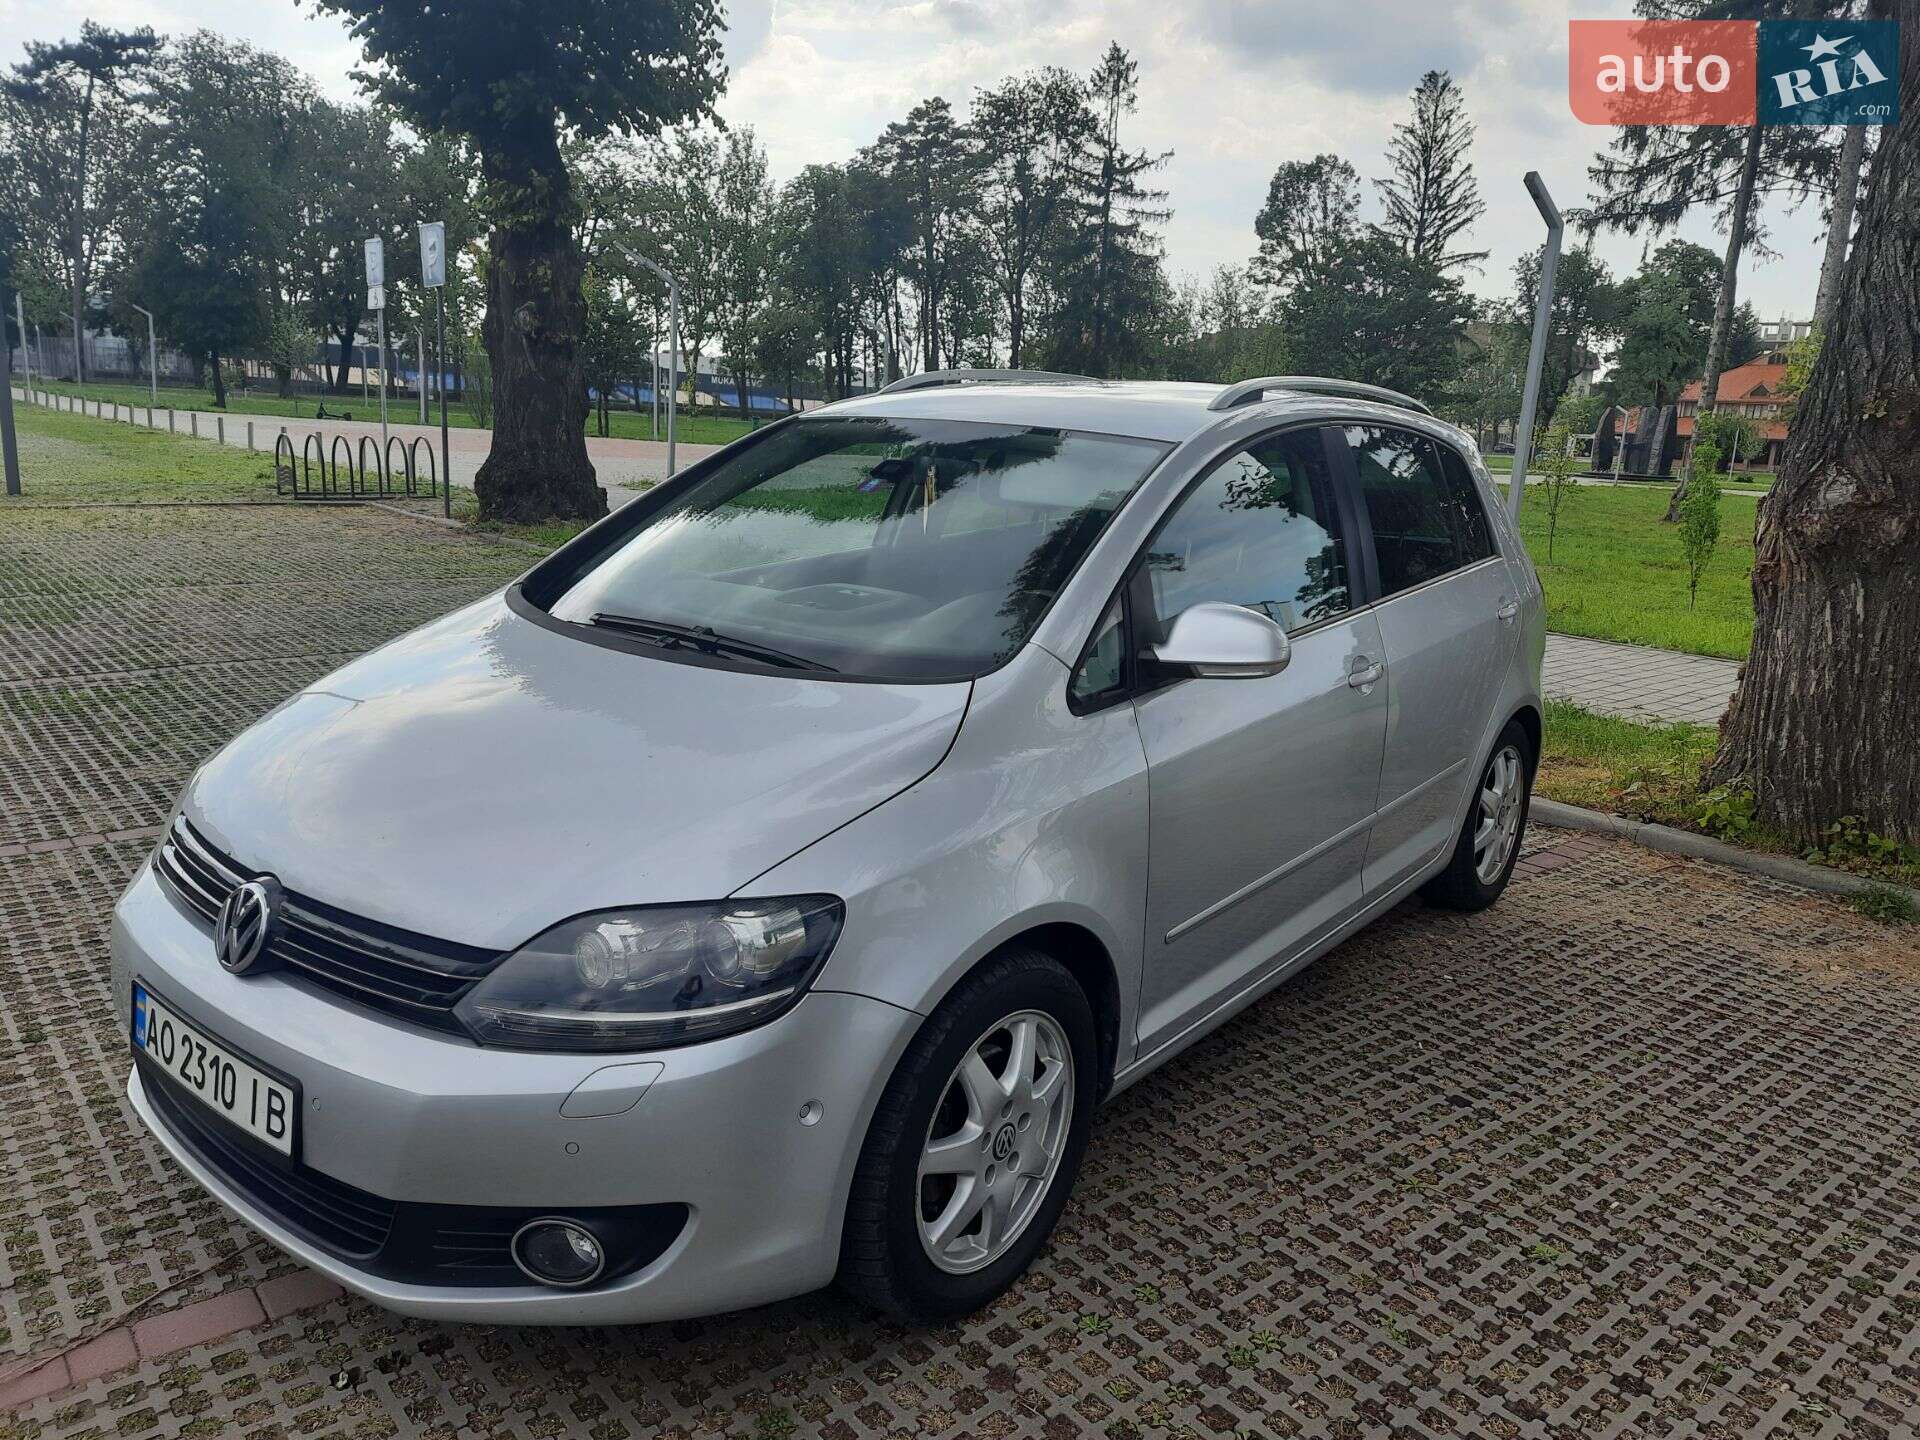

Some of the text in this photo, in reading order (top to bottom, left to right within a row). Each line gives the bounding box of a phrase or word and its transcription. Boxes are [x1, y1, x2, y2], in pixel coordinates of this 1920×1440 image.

[146, 1007, 286, 1139] AO 2310 IB
